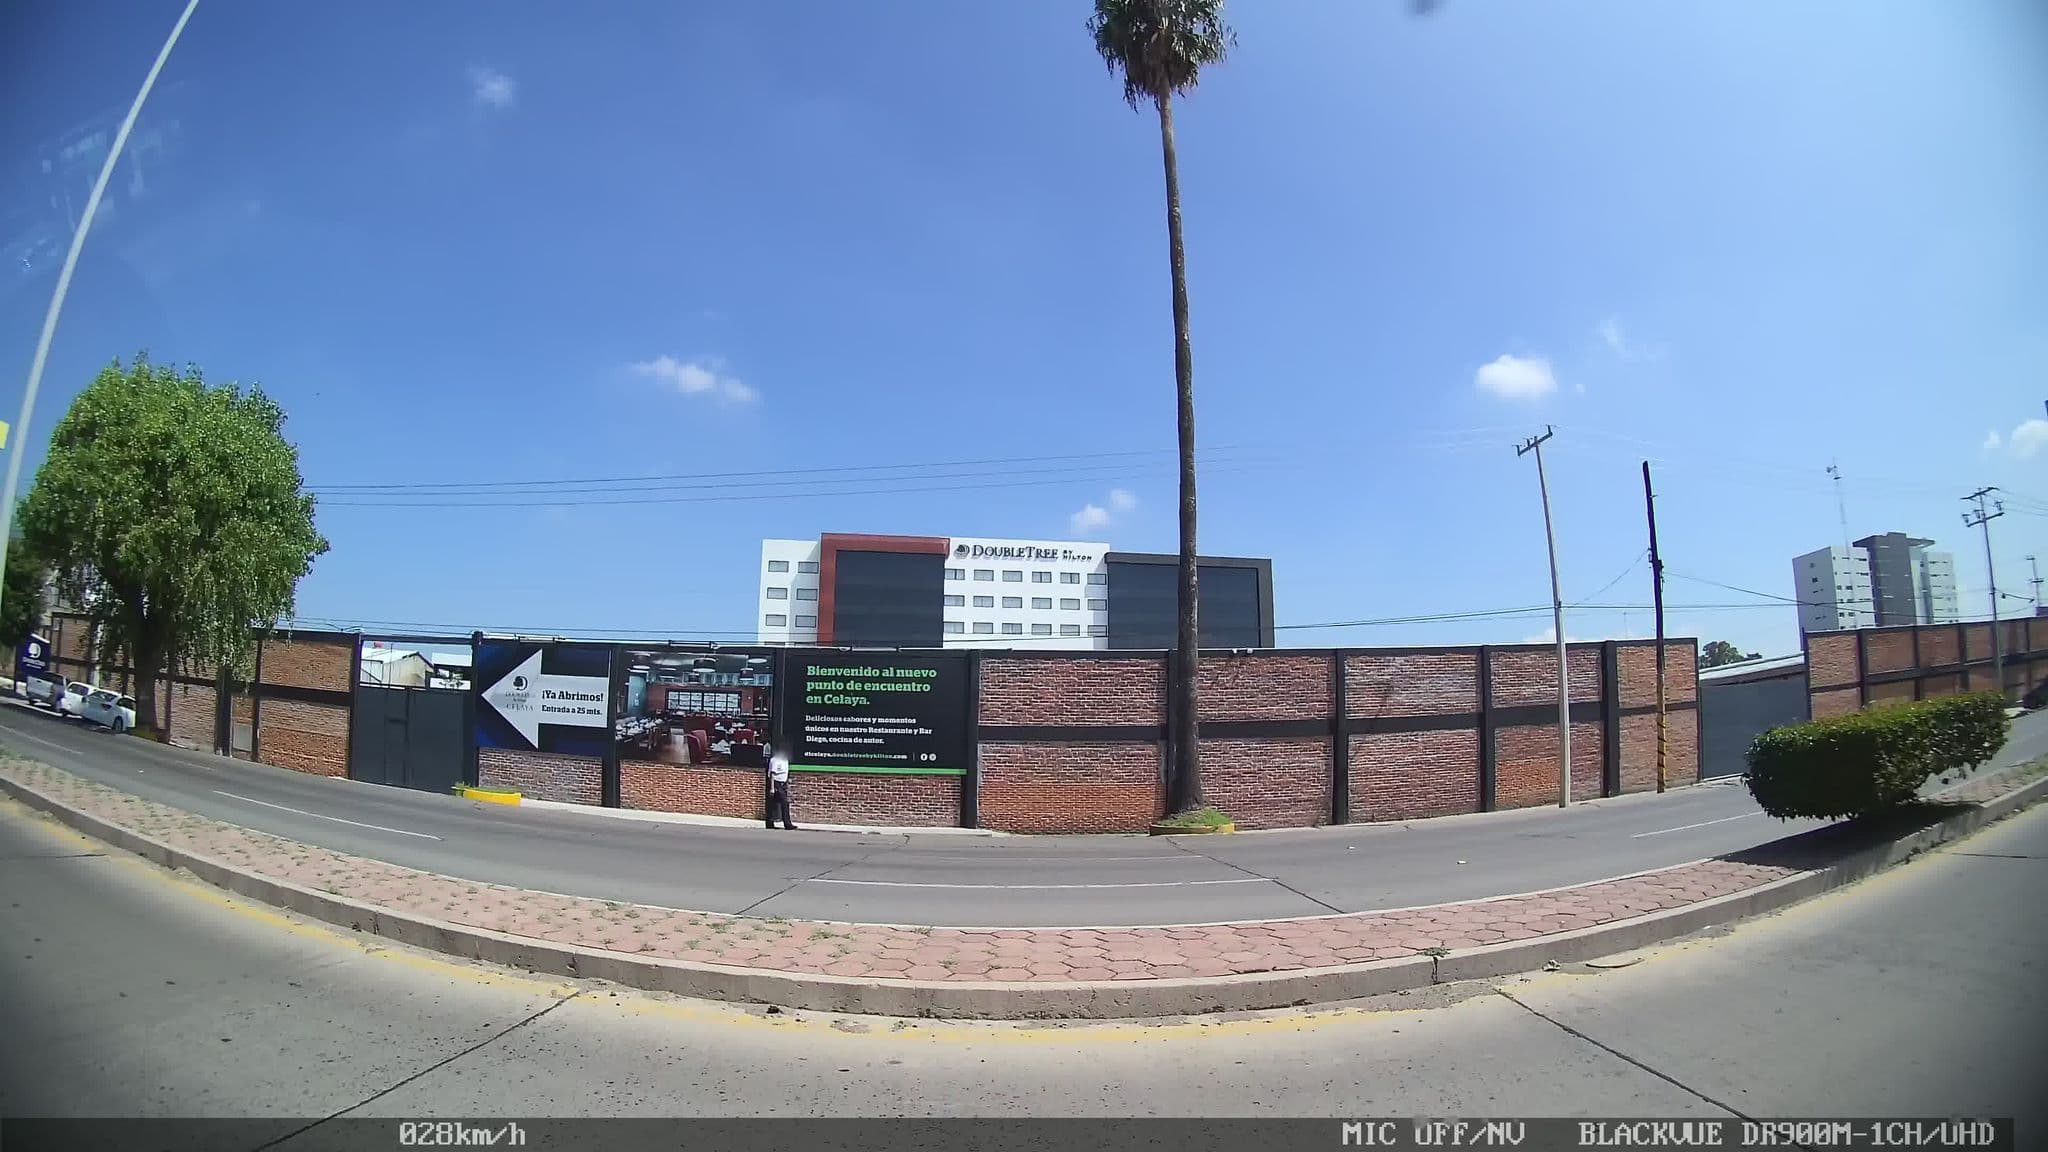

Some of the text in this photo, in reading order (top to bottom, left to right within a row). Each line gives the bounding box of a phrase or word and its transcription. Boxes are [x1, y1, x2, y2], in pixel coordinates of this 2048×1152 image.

[972, 544, 1059, 559] DOUBLETREE
[807, 665, 937, 678] Bienvenido al nuevo
[806, 680, 931, 692] punto de encuentro
[558, 691, 604, 702] Abrimos!
[806, 694, 870, 707] en Celaya.
[541, 704, 570, 714] Entrada
[576, 706, 586, 715] 25
[586, 707, 603, 715] mts.
[804, 724, 829, 732] únicos
[868, 726, 913, 734] Restaurante
[919, 727, 933, 735] Bar
